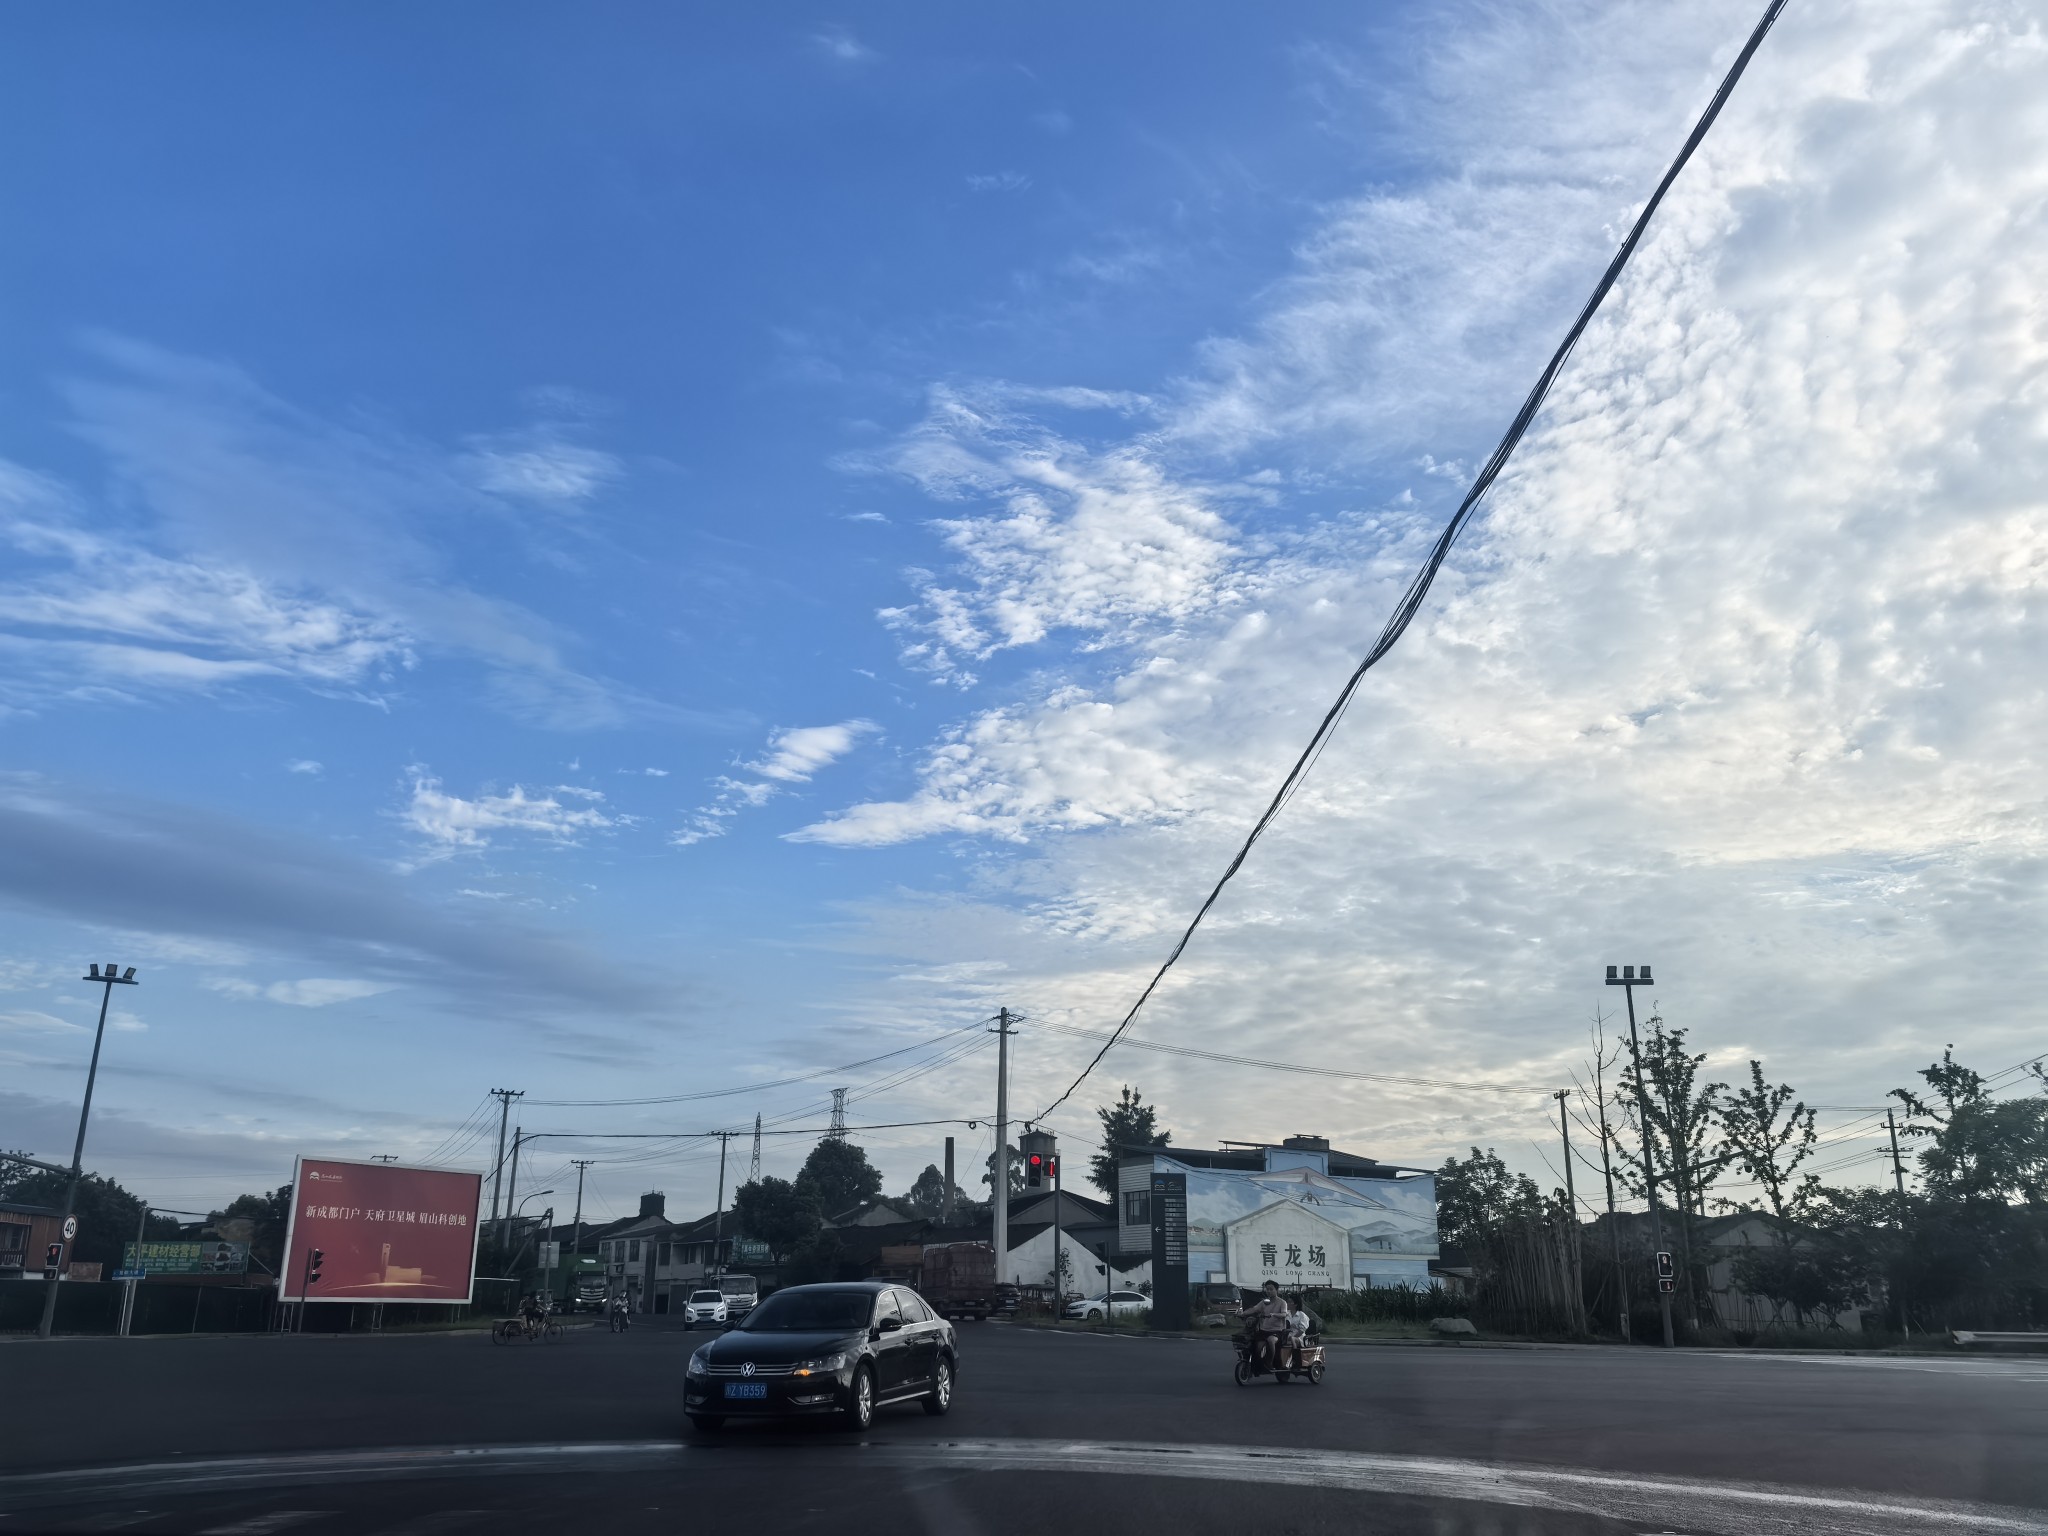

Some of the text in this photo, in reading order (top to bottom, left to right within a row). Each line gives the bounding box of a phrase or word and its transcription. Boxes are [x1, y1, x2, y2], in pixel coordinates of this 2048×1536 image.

[306, 1205, 467, 1226] 新成都门户 天府卫星城 眉山科创地
[65, 1221, 75, 1235] 40
[1260, 1243, 1326, 1268] 青龙场
